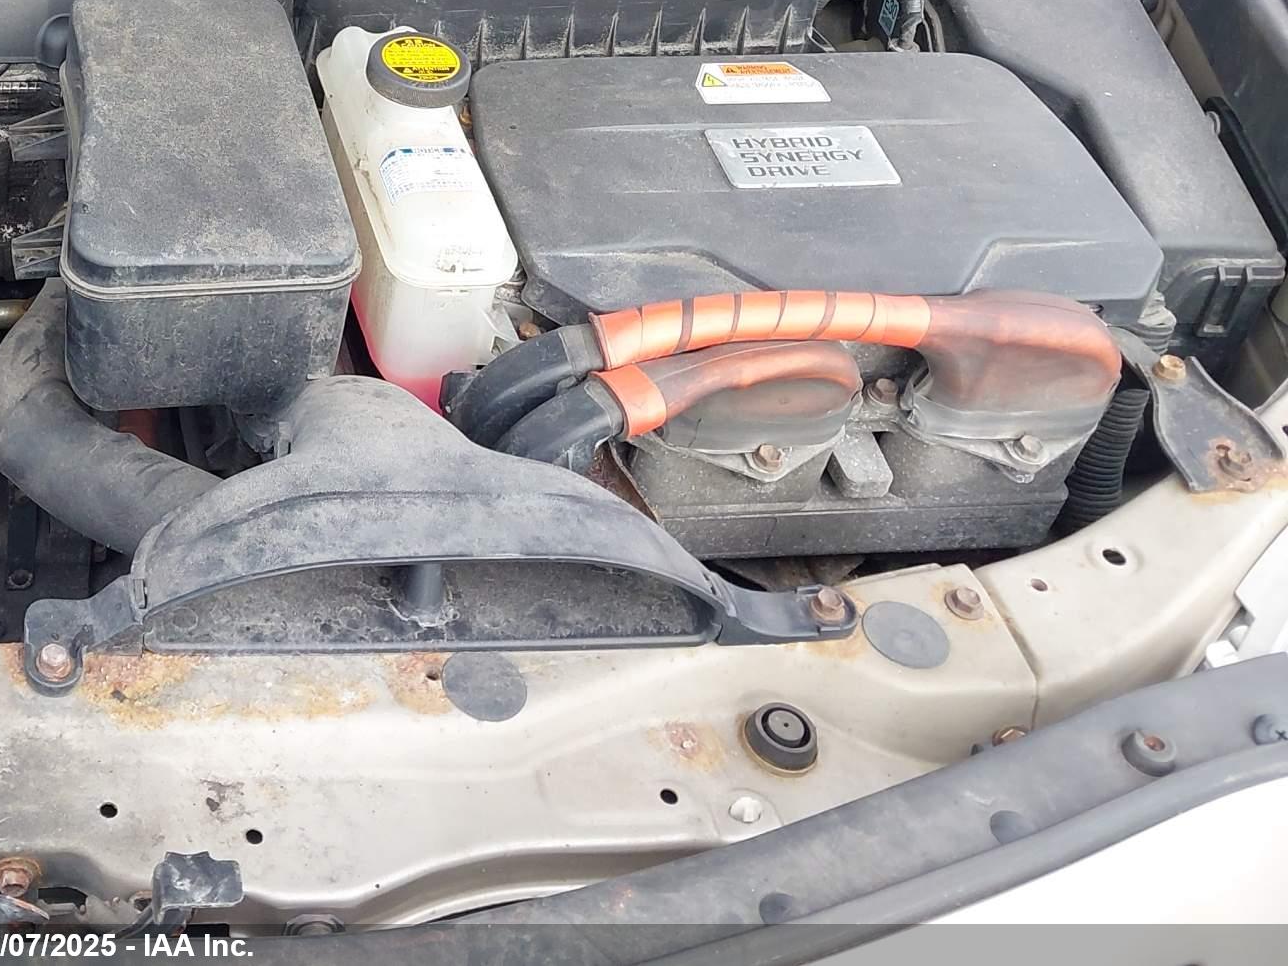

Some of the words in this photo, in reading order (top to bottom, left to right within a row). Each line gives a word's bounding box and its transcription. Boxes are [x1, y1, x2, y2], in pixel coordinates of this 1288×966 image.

[732, 136, 833, 149] HYBRID
[739, 149, 864, 163] SYNERGY
[747, 164, 831, 177] DRIVE
